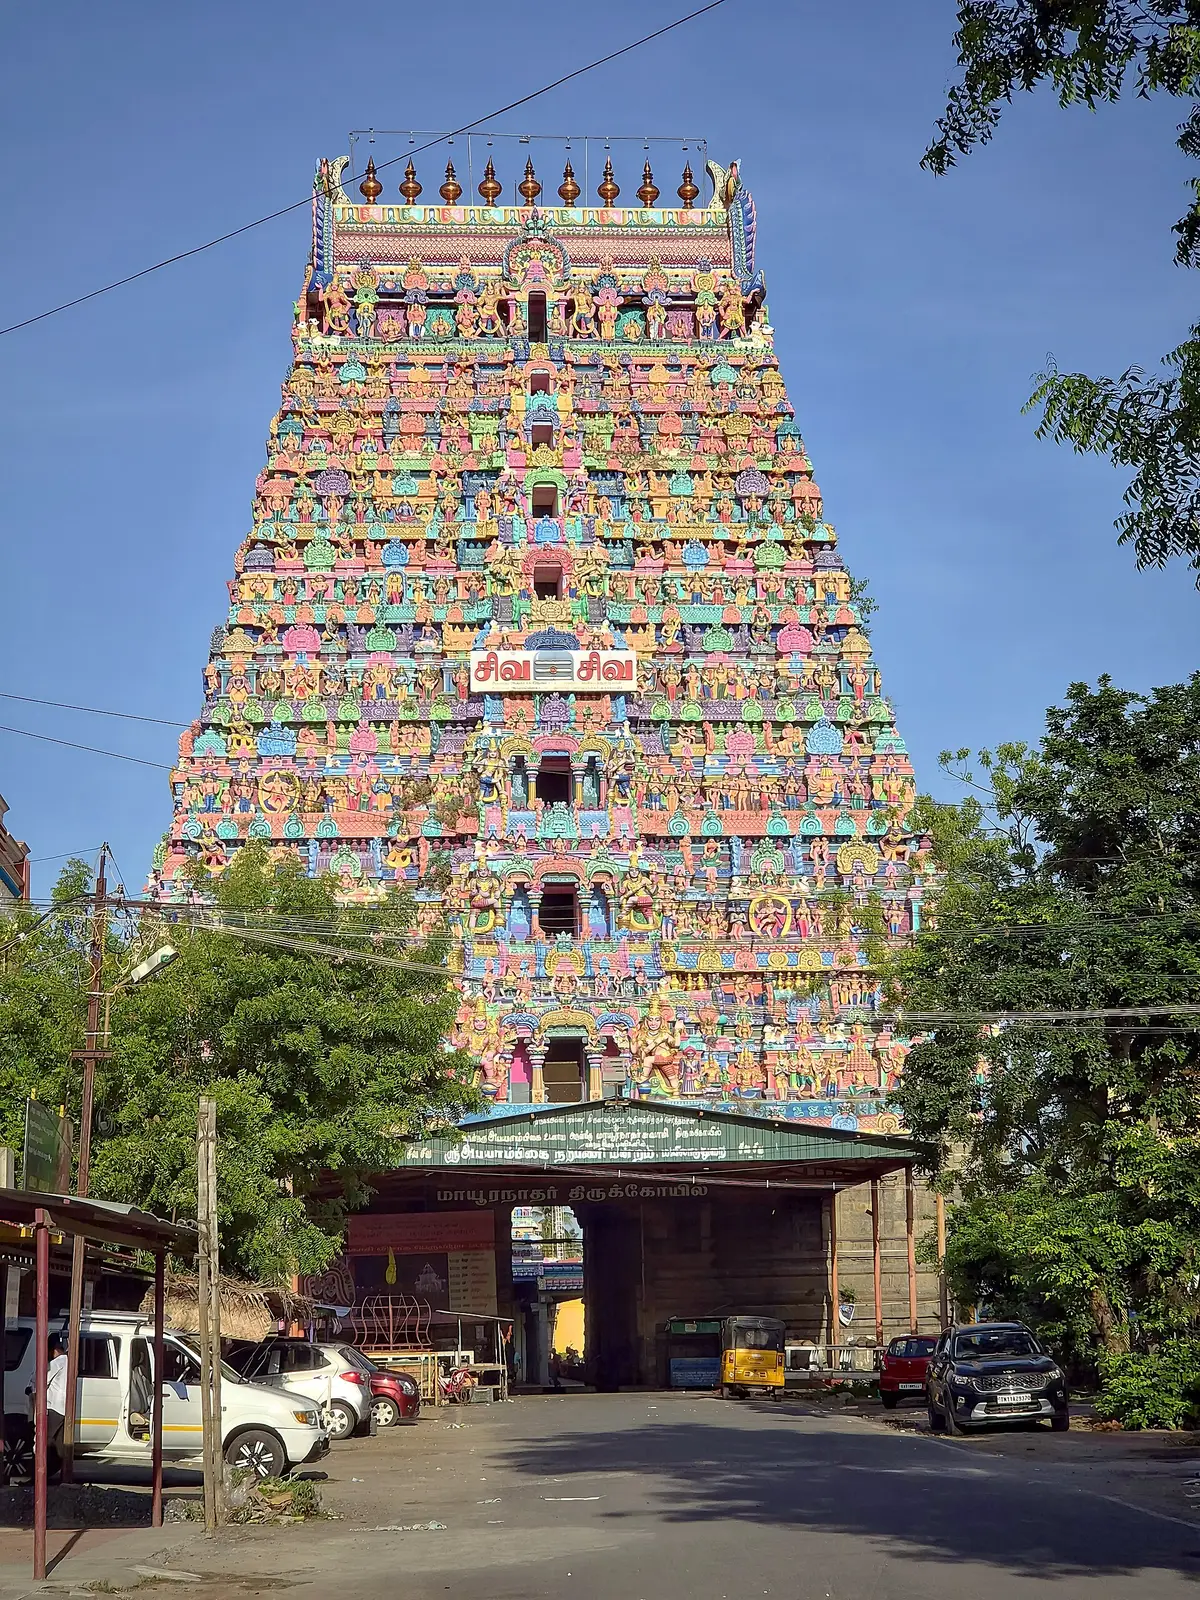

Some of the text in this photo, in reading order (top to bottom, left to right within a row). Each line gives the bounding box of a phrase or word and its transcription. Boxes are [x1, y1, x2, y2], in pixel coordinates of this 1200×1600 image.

[474, 651, 633, 681] சிவ சிவ
[437, 1186, 559, 1206] மாயூரநாதர்
